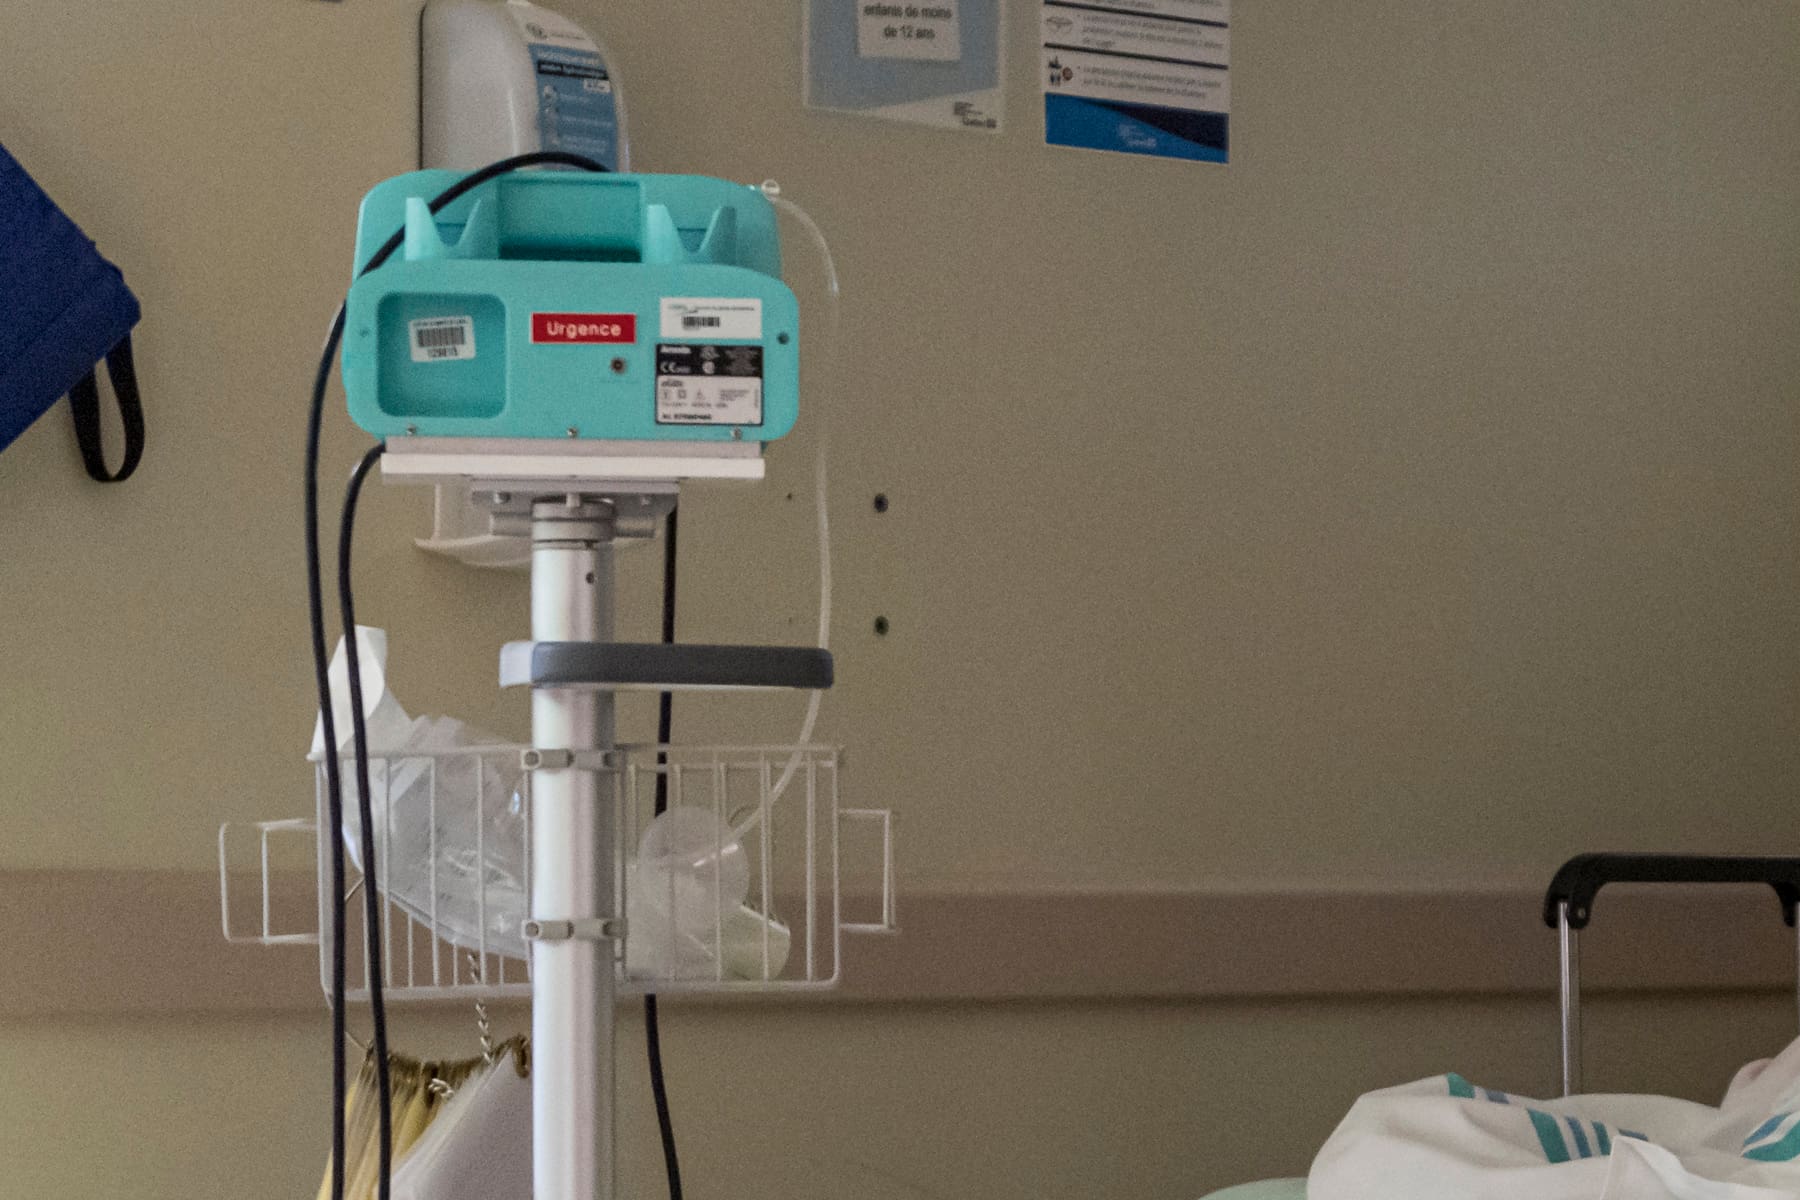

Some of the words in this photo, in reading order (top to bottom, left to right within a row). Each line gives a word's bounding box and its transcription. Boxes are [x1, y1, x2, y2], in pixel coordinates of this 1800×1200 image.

[864, 3, 902, 17] enfants
[905, 3, 919, 18] de
[921, 6, 952, 19] moins
[884, 25, 898, 38] de
[899, 24, 913, 38] 12
[916, 28, 936, 39] ans
[546, 320, 622, 339] Urgence
